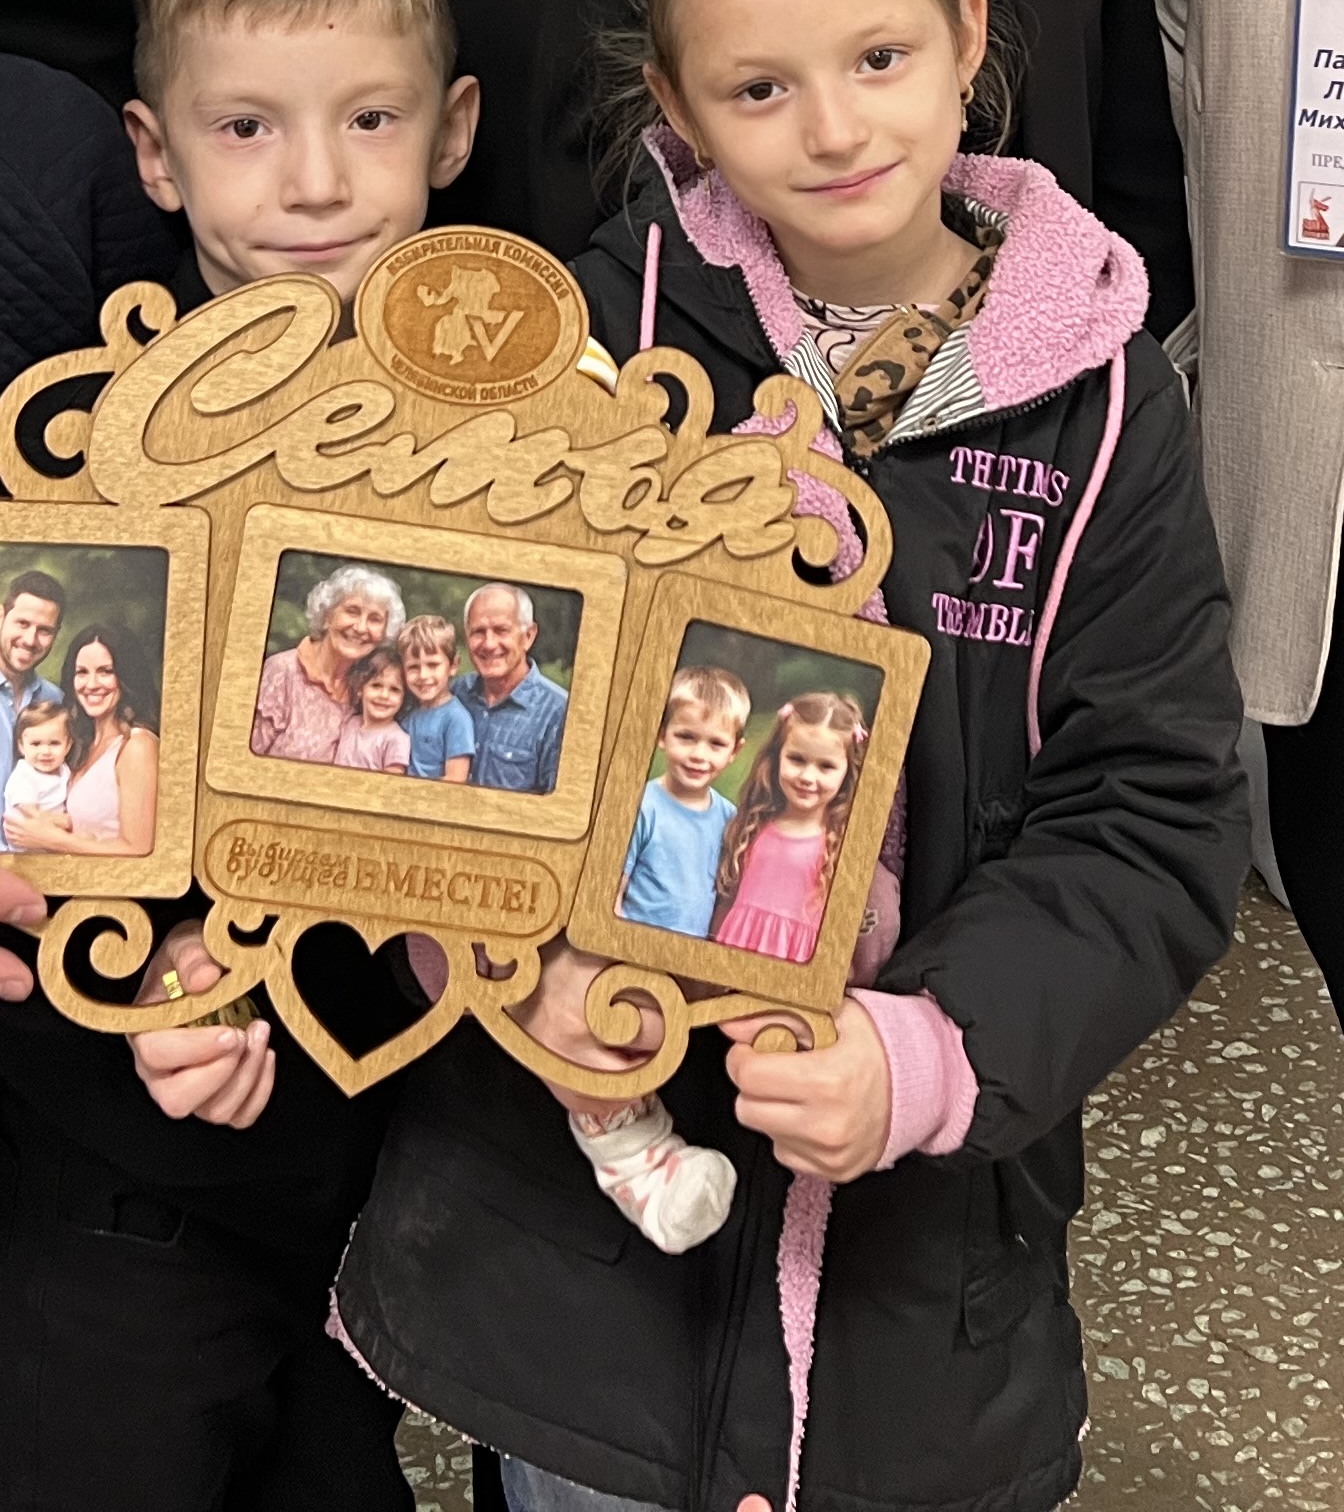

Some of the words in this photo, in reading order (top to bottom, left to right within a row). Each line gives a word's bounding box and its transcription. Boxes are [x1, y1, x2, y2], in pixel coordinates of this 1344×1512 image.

[386, 236, 502, 277] ИЗБИРАТЕЛЬНАЯ
[503, 243, 570, 301] КОМИССИЯ
[479, 374, 539, 401] ОБЛАСТИ
[90, 273, 799, 567] Семья
[229, 836, 351, 869] Выбираем
[354, 856, 541, 915] ВМЕСТЕ!
